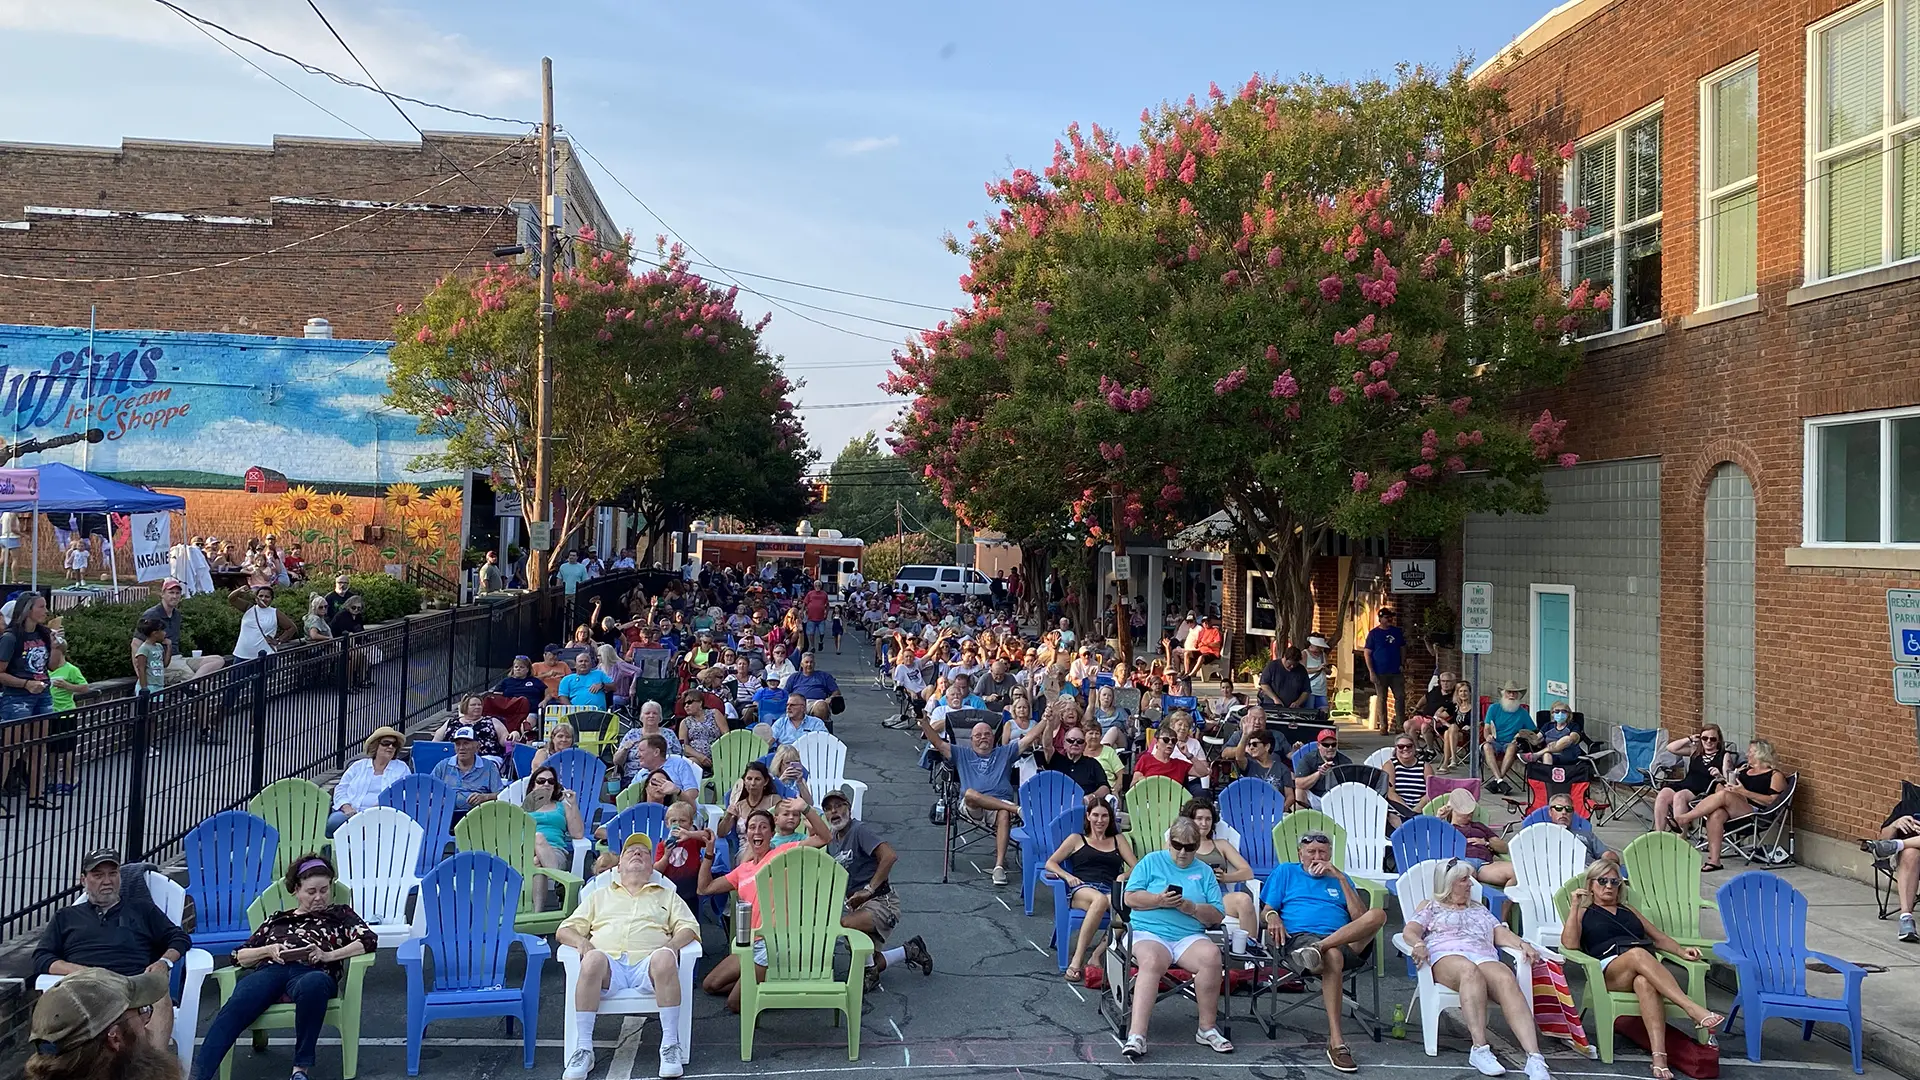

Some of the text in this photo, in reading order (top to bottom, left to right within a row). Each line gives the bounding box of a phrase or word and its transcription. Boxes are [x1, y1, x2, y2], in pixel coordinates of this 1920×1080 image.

[64, 387, 172, 428] Ice Cream
[107, 403, 191, 440] Shoppe
[1470, 597, 1485, 605] HOUR
[1466, 607, 1488, 615] PARKING
[1470, 617, 1484, 625] ONLY
